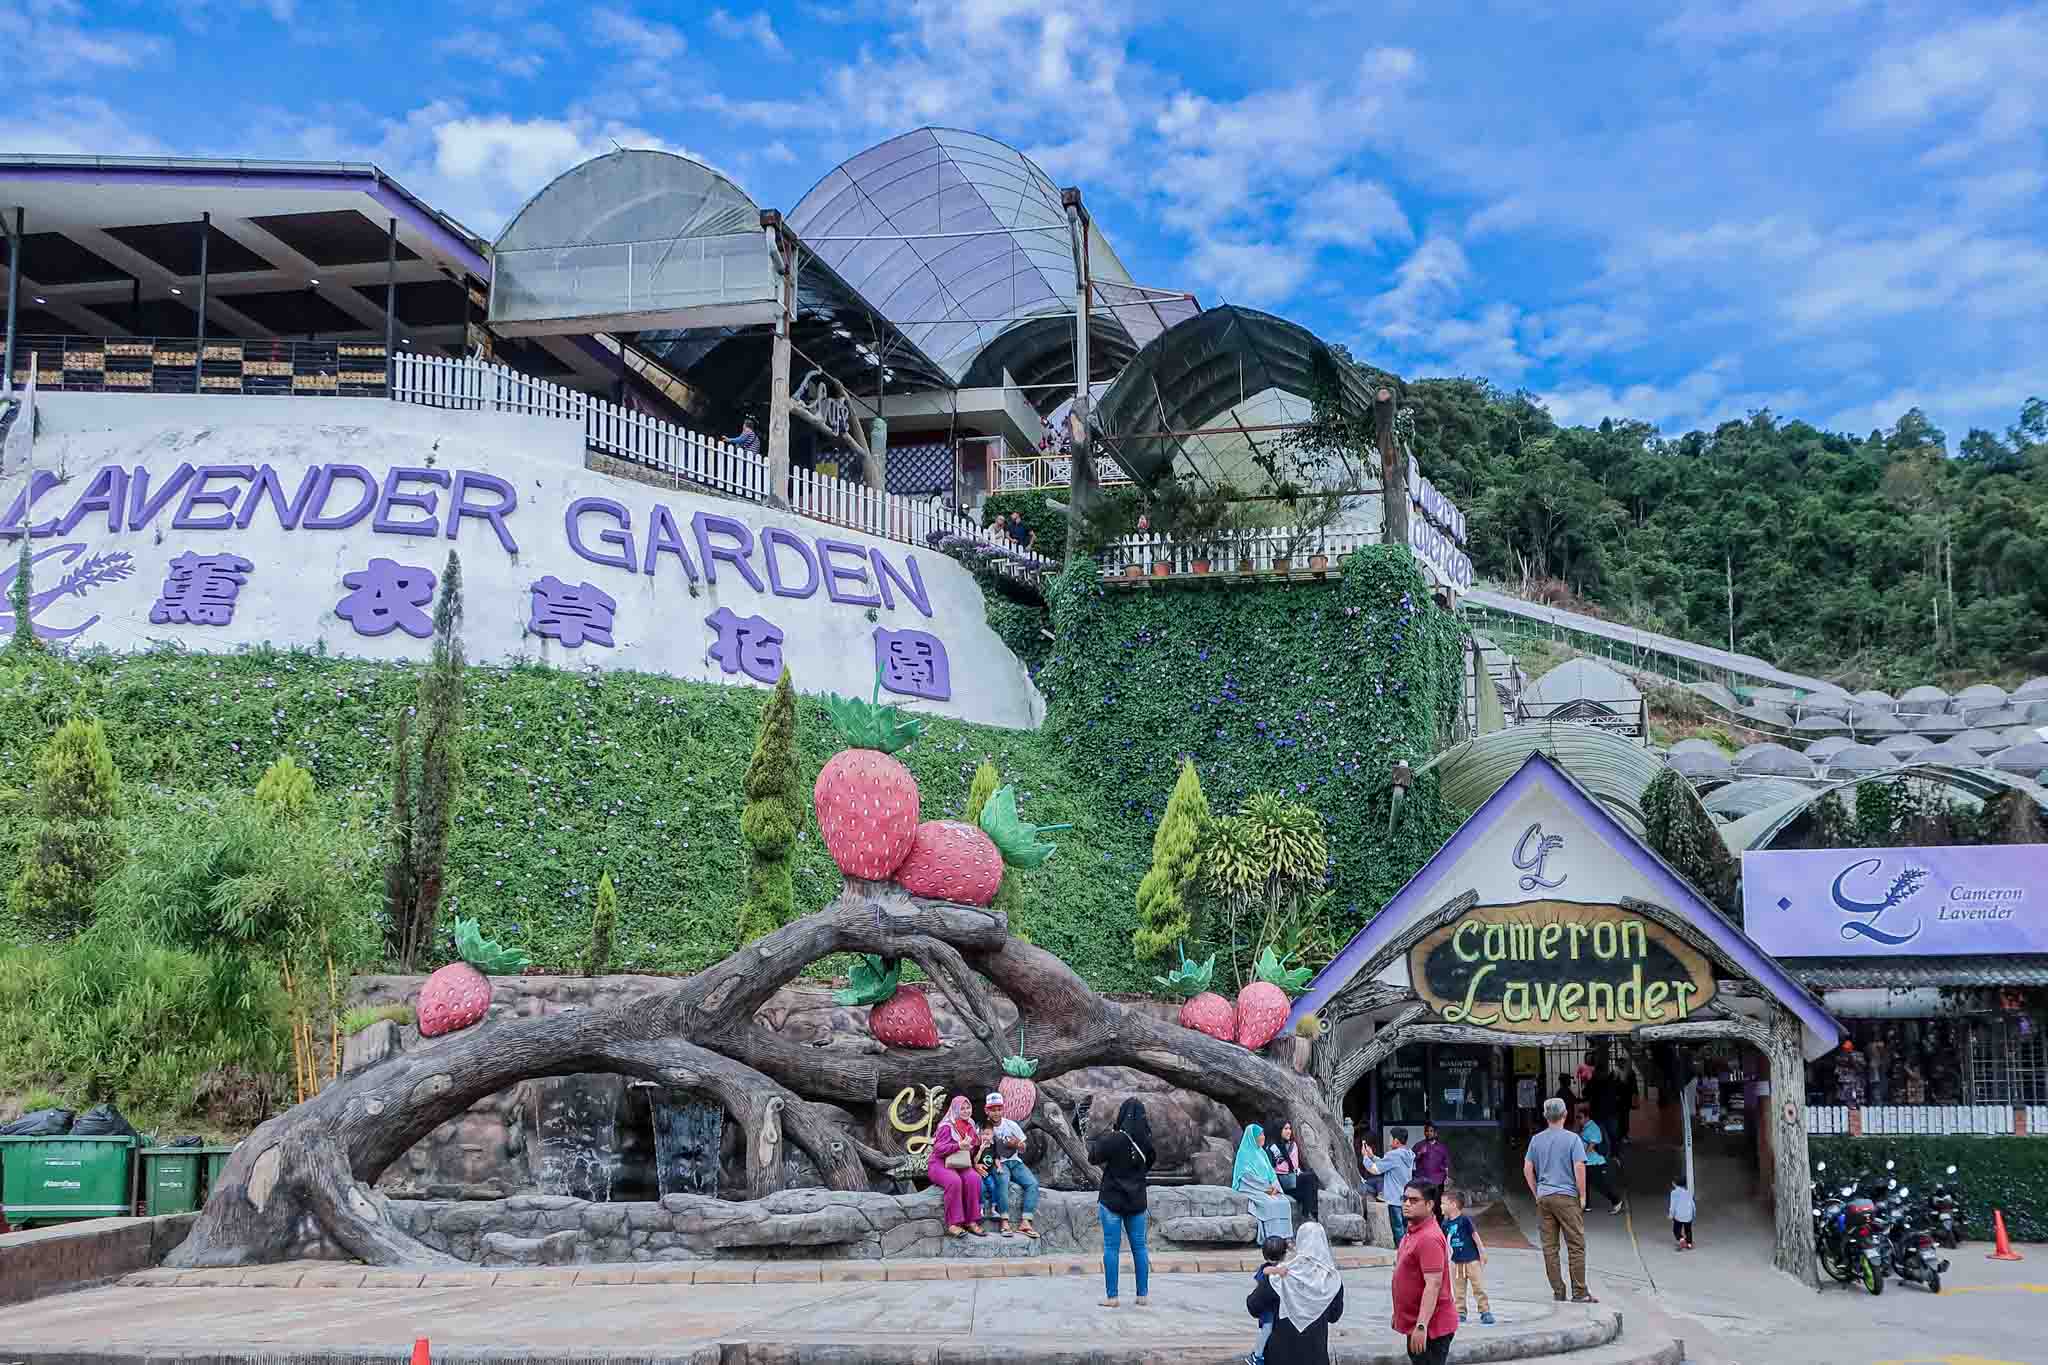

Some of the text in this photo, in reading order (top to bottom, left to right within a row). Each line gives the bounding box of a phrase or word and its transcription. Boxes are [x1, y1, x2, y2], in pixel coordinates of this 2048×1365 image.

[0, 463, 932, 618] LAVENDER GARDEN
[1411, 518, 1473, 590] avender
[1937, 905, 2014, 920] Lavender
[1949, 886, 2023, 901] Cameron
[1453, 918, 1648, 963] Cameron
[1442, 964, 1698, 1027] Lavender
